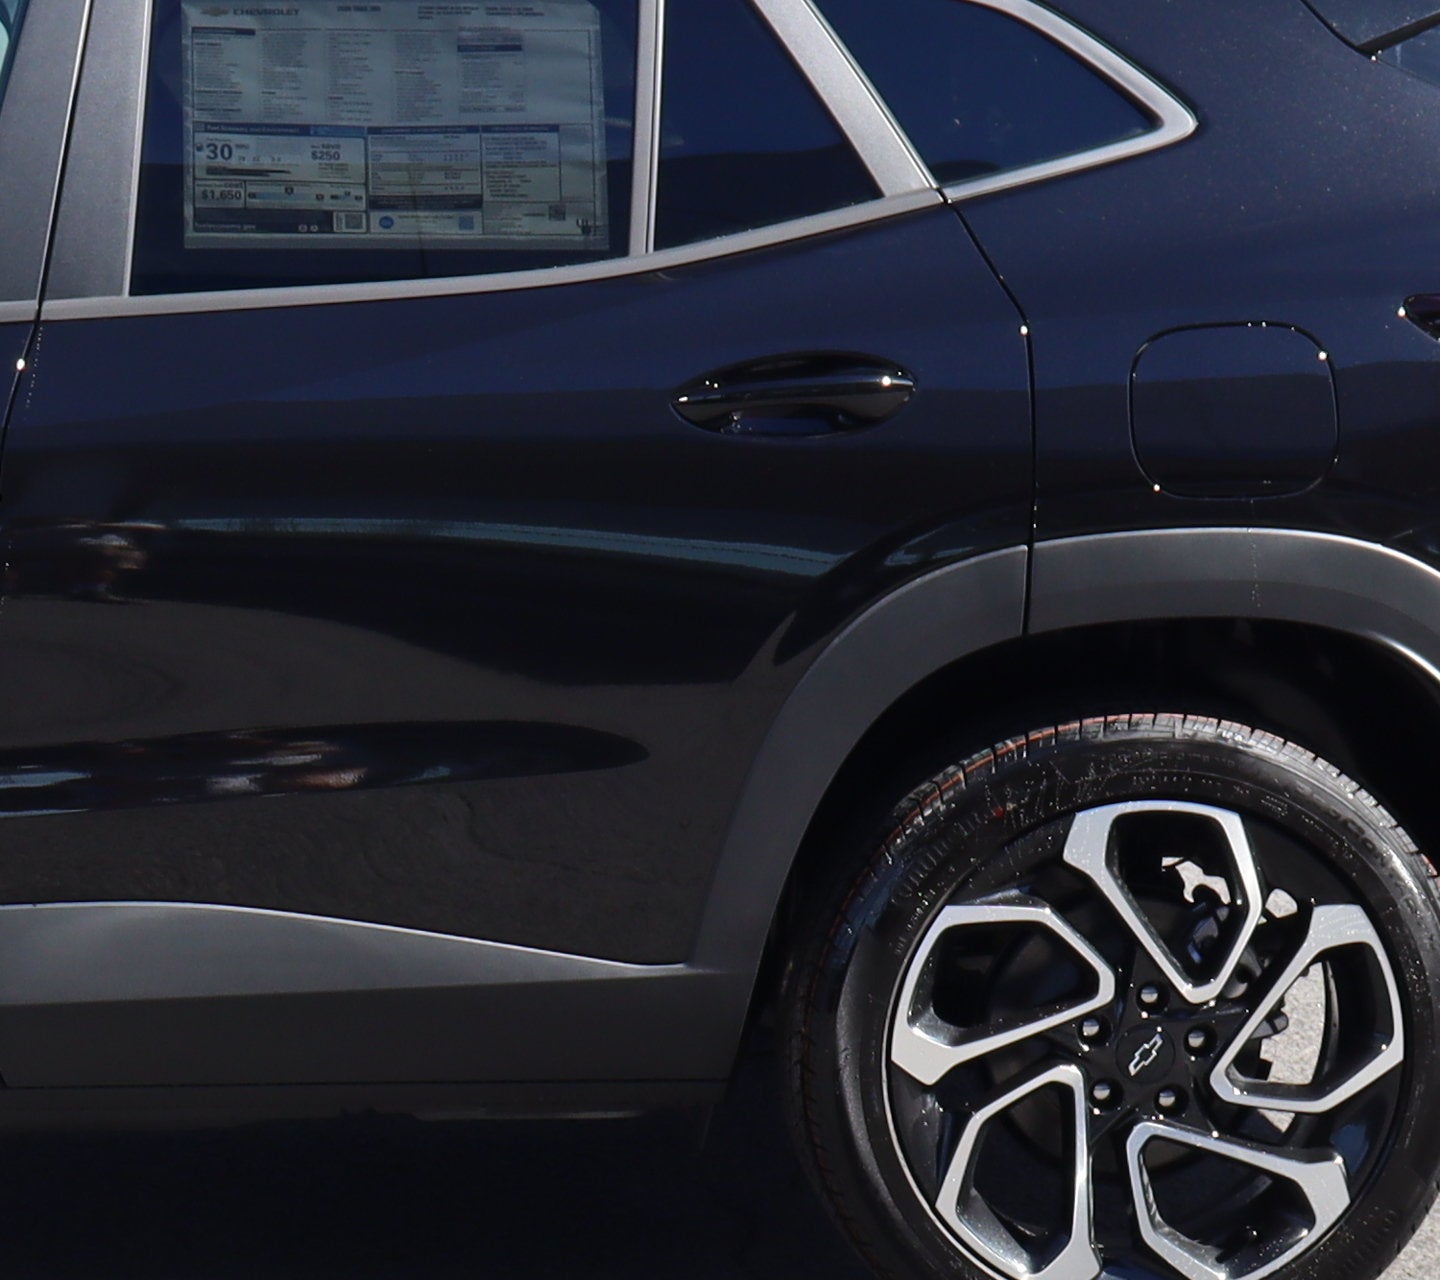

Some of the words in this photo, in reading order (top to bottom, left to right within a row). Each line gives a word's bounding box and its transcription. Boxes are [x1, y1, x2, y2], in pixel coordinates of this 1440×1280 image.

[232, 7, 300, 17] CHEVROLET
[205, 142, 234, 161] 30
[310, 150, 341, 162] $250
[201, 189, 242, 201] $1,650
